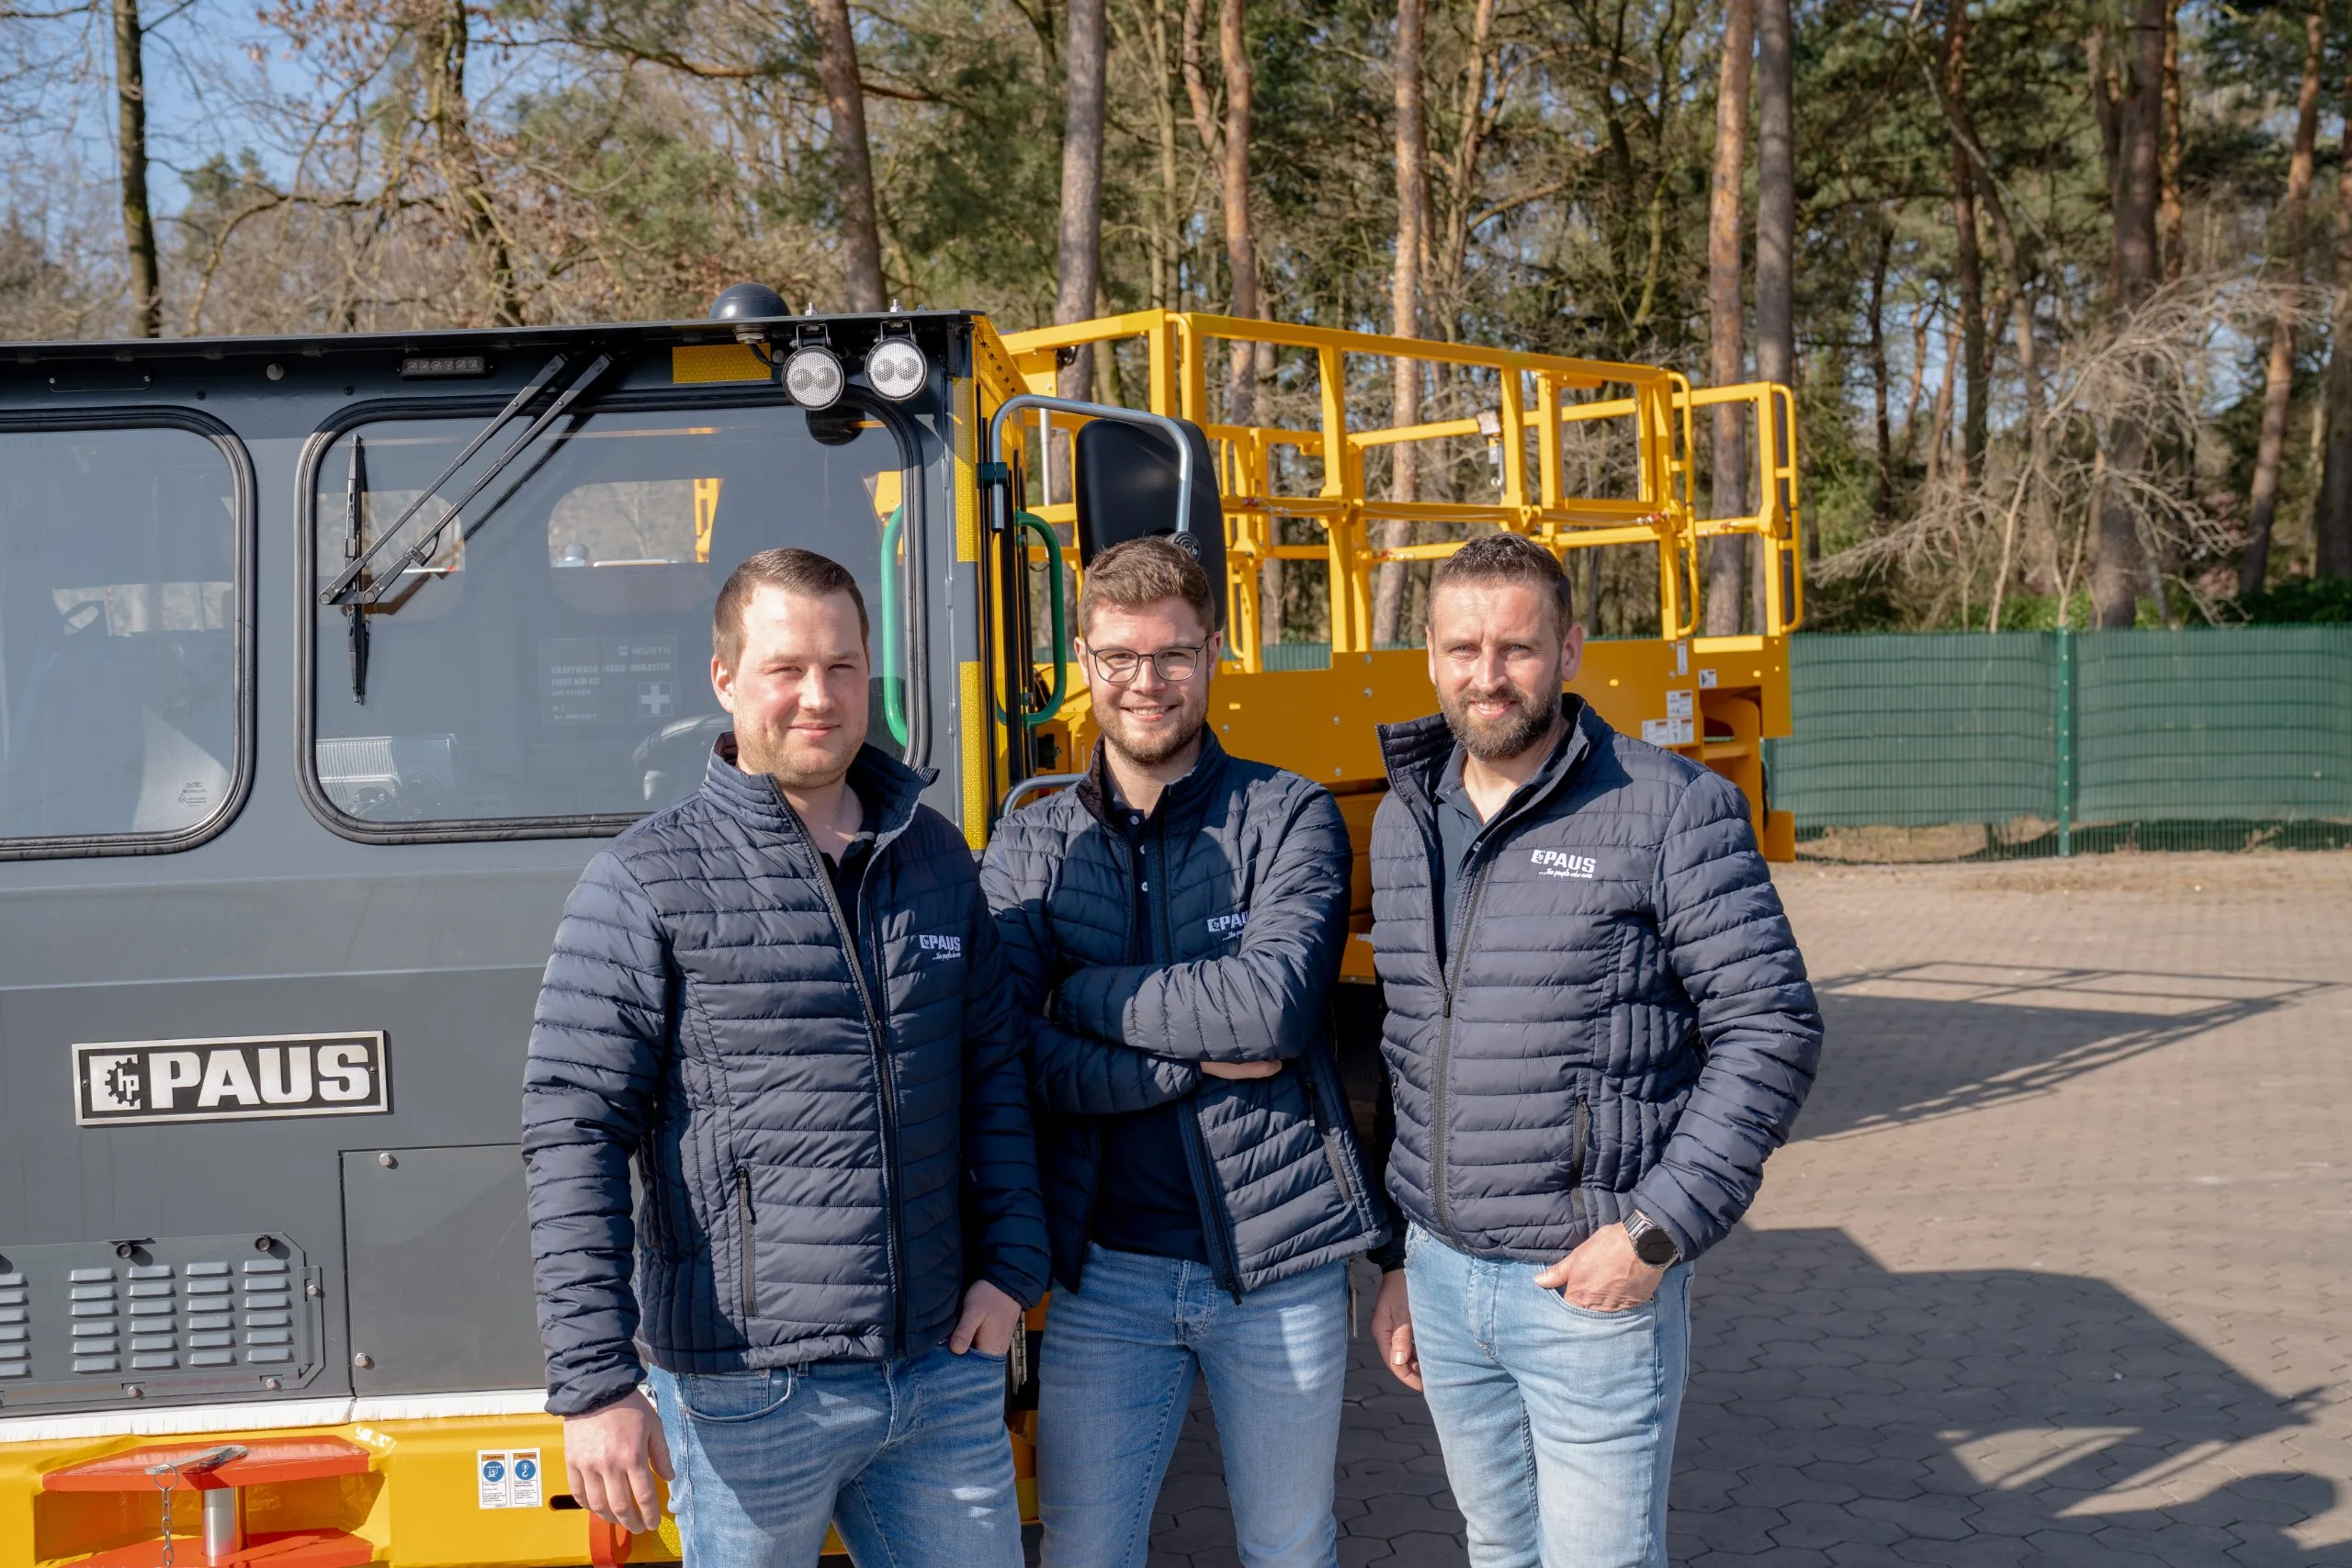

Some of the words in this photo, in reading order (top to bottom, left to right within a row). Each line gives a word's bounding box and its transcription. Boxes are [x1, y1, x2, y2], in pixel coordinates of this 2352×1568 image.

[1543, 851, 1596, 874] PAUS
[1219, 909, 1250, 931] PAU
[928, 934, 961, 952] PAUS
[148, 1044, 371, 1110] PAUS
